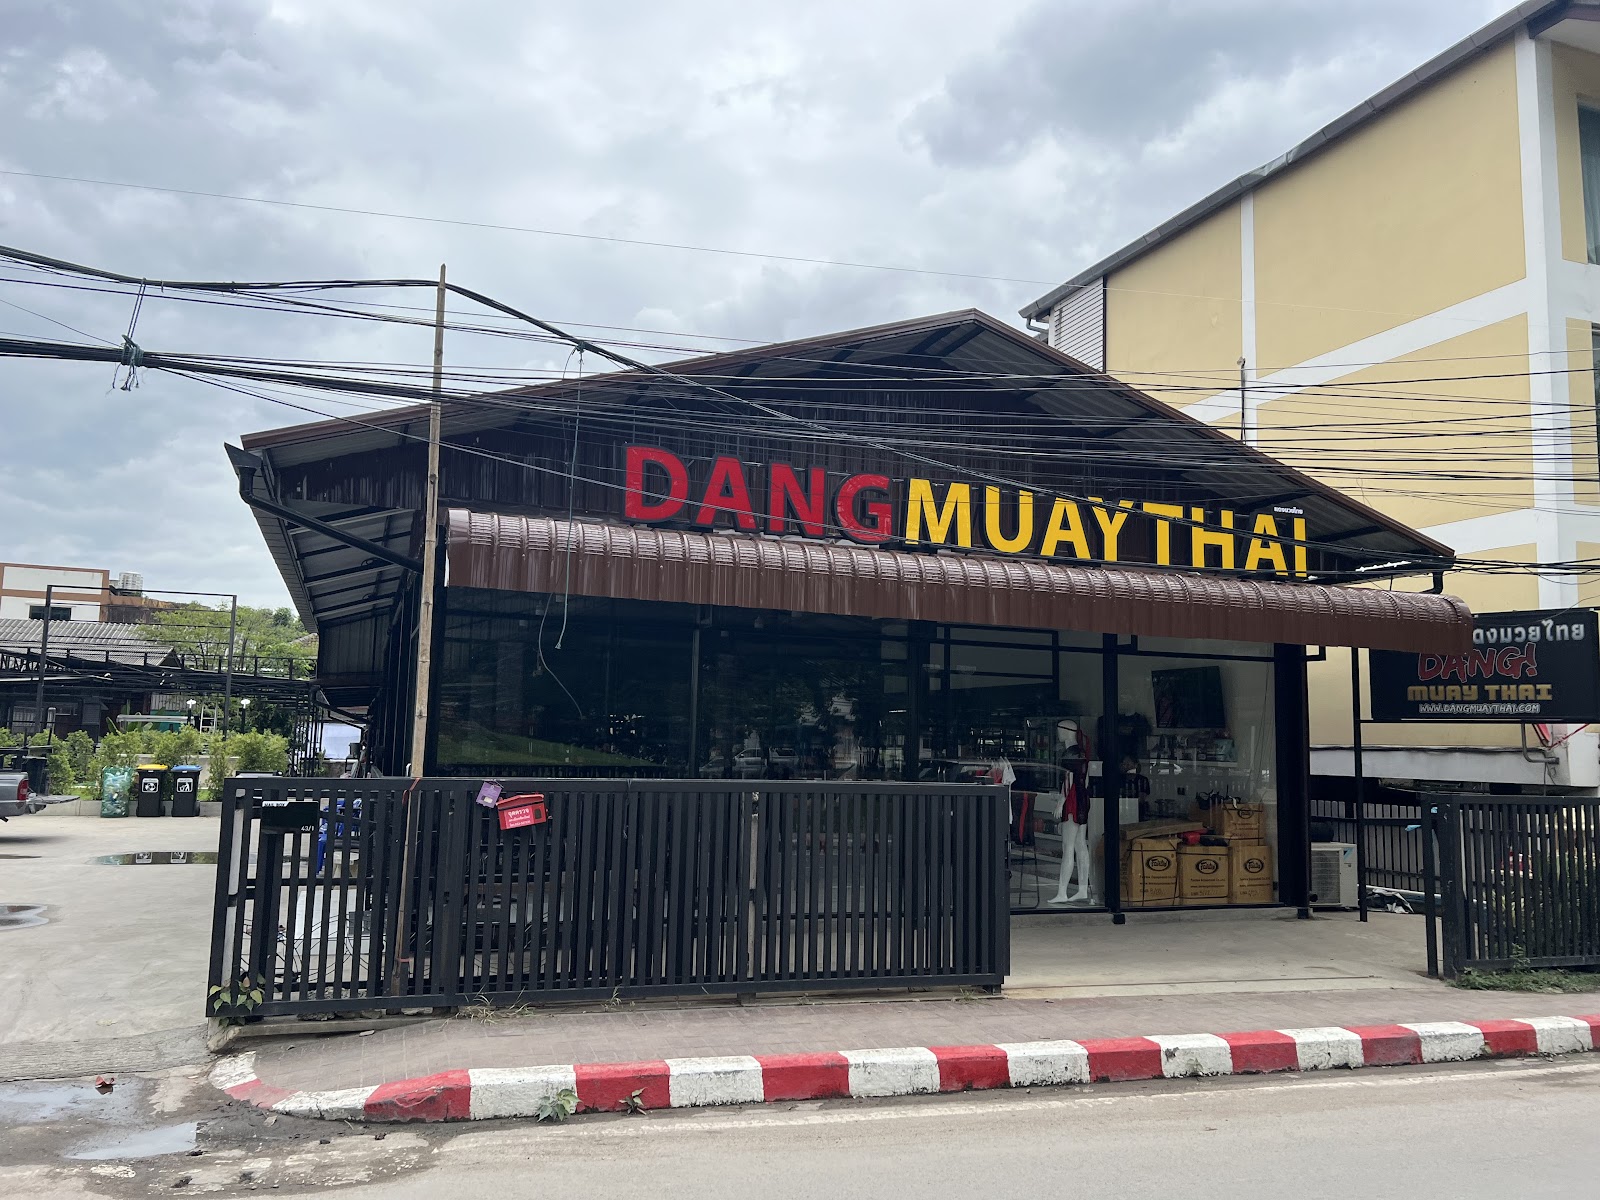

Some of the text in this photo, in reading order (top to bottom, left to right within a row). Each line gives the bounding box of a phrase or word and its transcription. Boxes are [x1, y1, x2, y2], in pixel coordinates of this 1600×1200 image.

[624, 446, 892, 543] DANG
[1472, 619, 1585, 644] ดงมวยไทย
[1418, 642, 1538, 683] DANG!
[1407, 684, 1553, 701] MUAY THAI
[1419, 703, 1541, 714] WWW.DANGMUAYTHAI.COM
